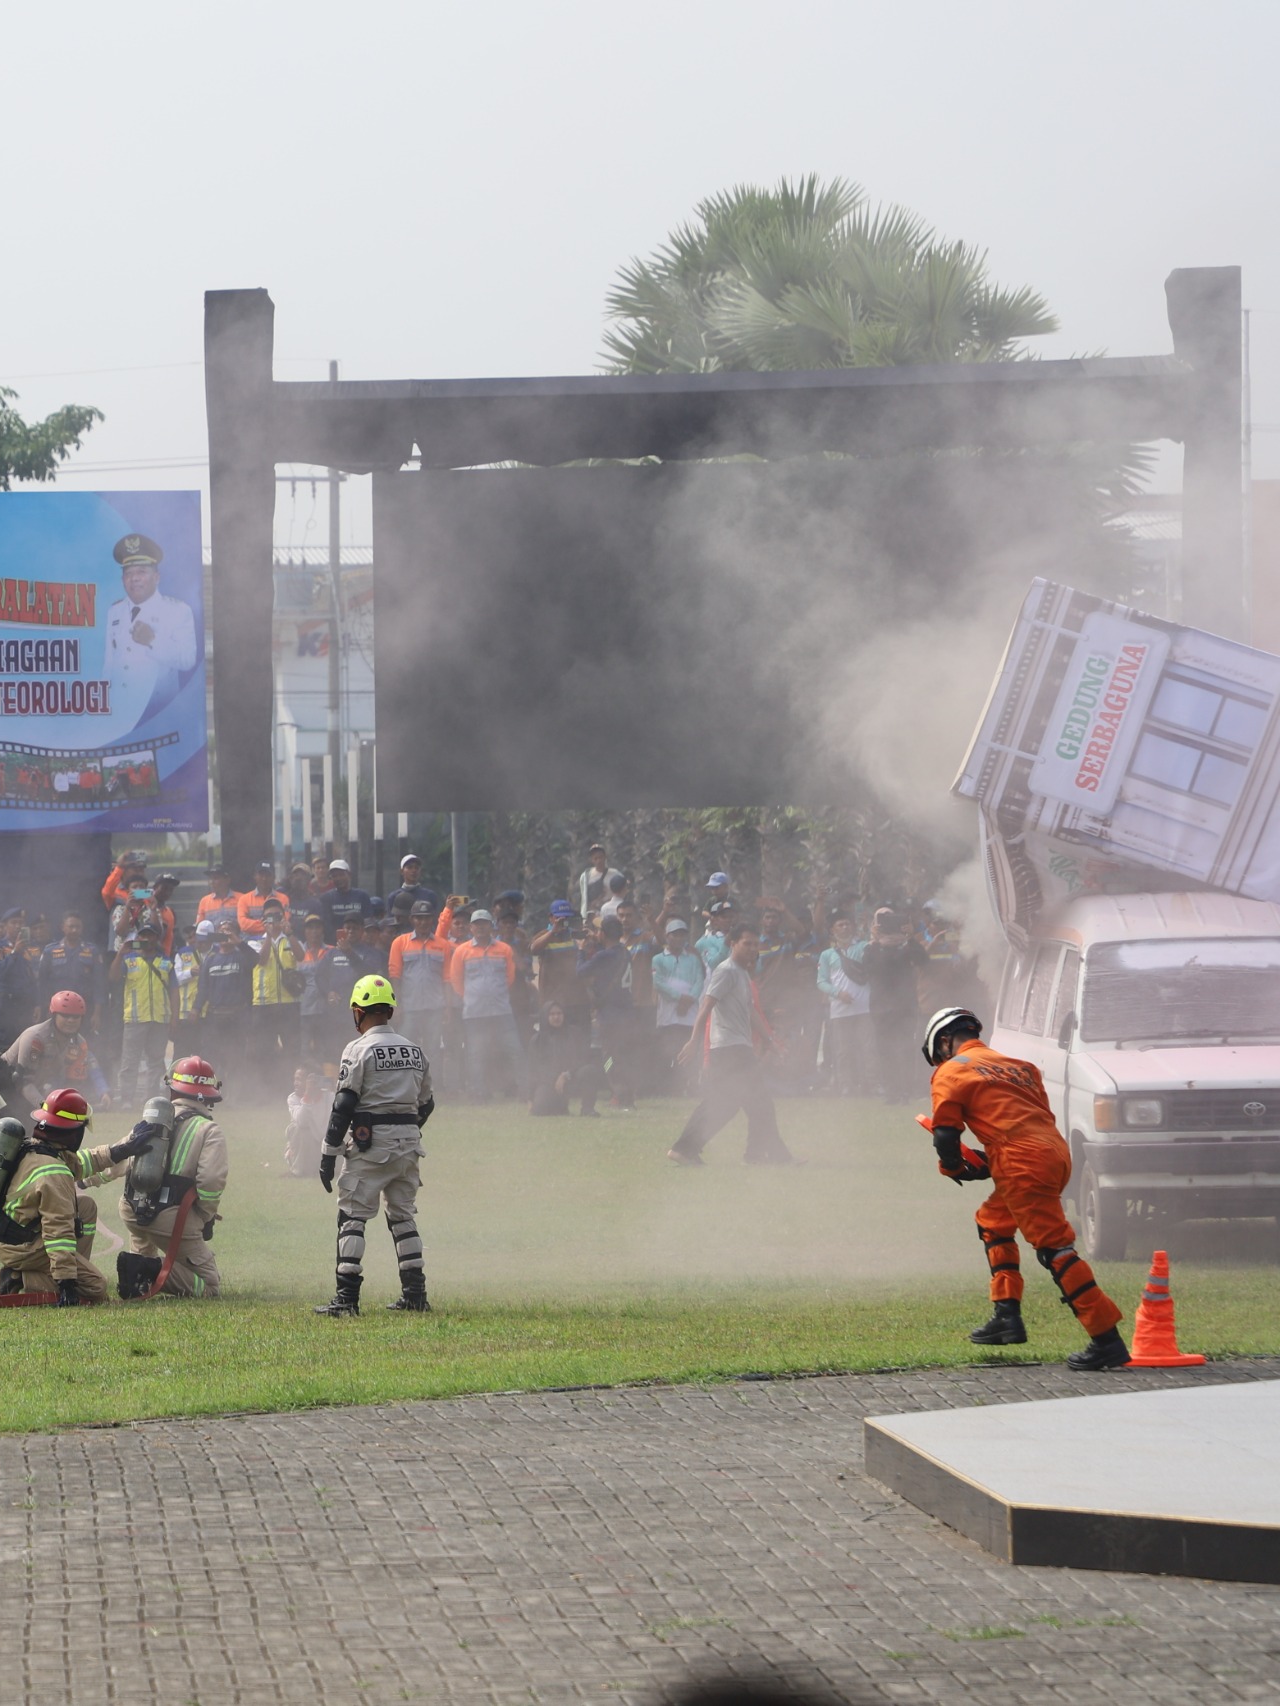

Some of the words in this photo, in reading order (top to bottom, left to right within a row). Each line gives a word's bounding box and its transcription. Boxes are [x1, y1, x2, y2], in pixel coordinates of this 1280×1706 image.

[1055, 656, 1111, 762] GEDUNG
[1074, 643, 1149, 793] SERBAGUNA
[376, 1047, 420, 1060] BPBD
[378, 1060, 422, 1069] JOMBANG
